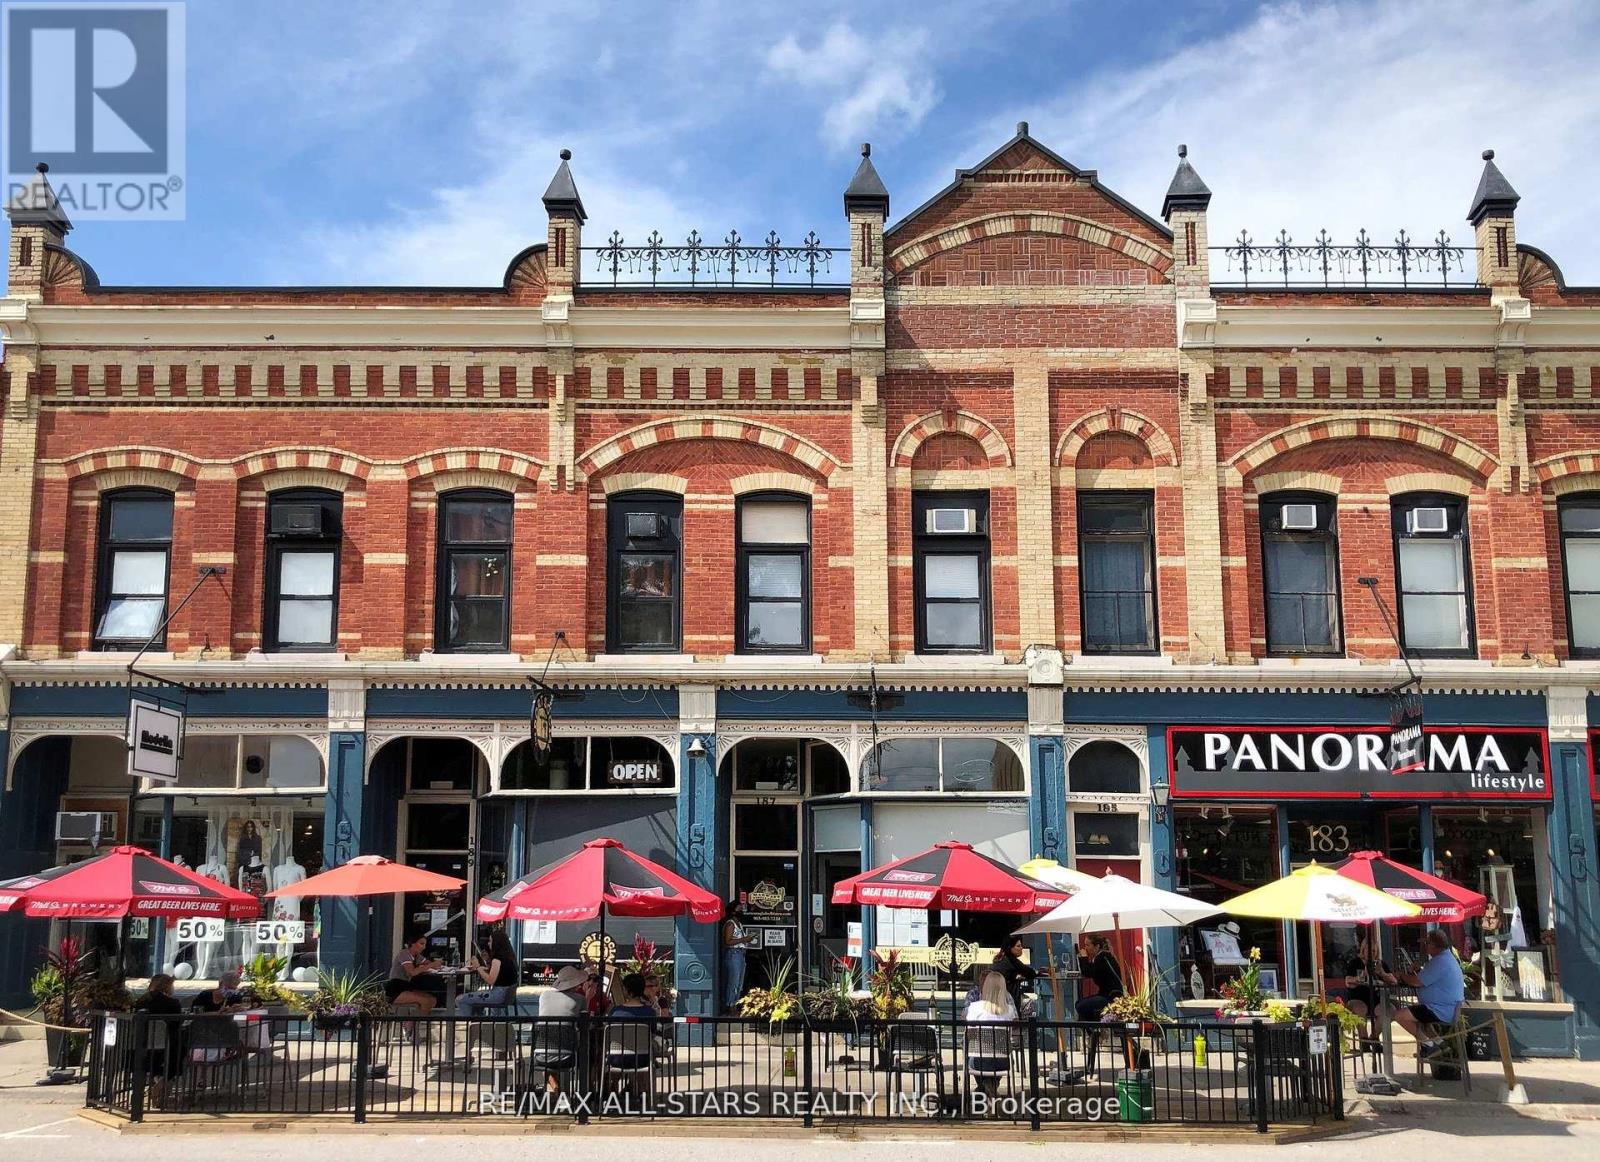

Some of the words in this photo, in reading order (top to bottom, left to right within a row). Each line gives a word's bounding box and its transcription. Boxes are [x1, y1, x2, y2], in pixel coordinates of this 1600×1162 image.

[1203, 732, 1511, 772] PANORMA
[612, 763, 658, 780] OPEN
[1470, 773, 1545, 793] lifestyle
[756, 796, 776, 806] 187
[1307, 825, 1350, 852] 183
[861, 887, 881, 897] GREAT
[882, 888, 900, 898] BEER
[899, 889, 916, 899] LIVES
[137, 900, 161, 910] GREAT
[161, 900, 181, 911] BEER
[181, 901, 200, 911] LIVES
[1421, 906, 1440, 916] LIVES
[178, 921, 223, 939] 50%
[257, 923, 303, 941] 50%
[579, 932, 597, 955] PORT
